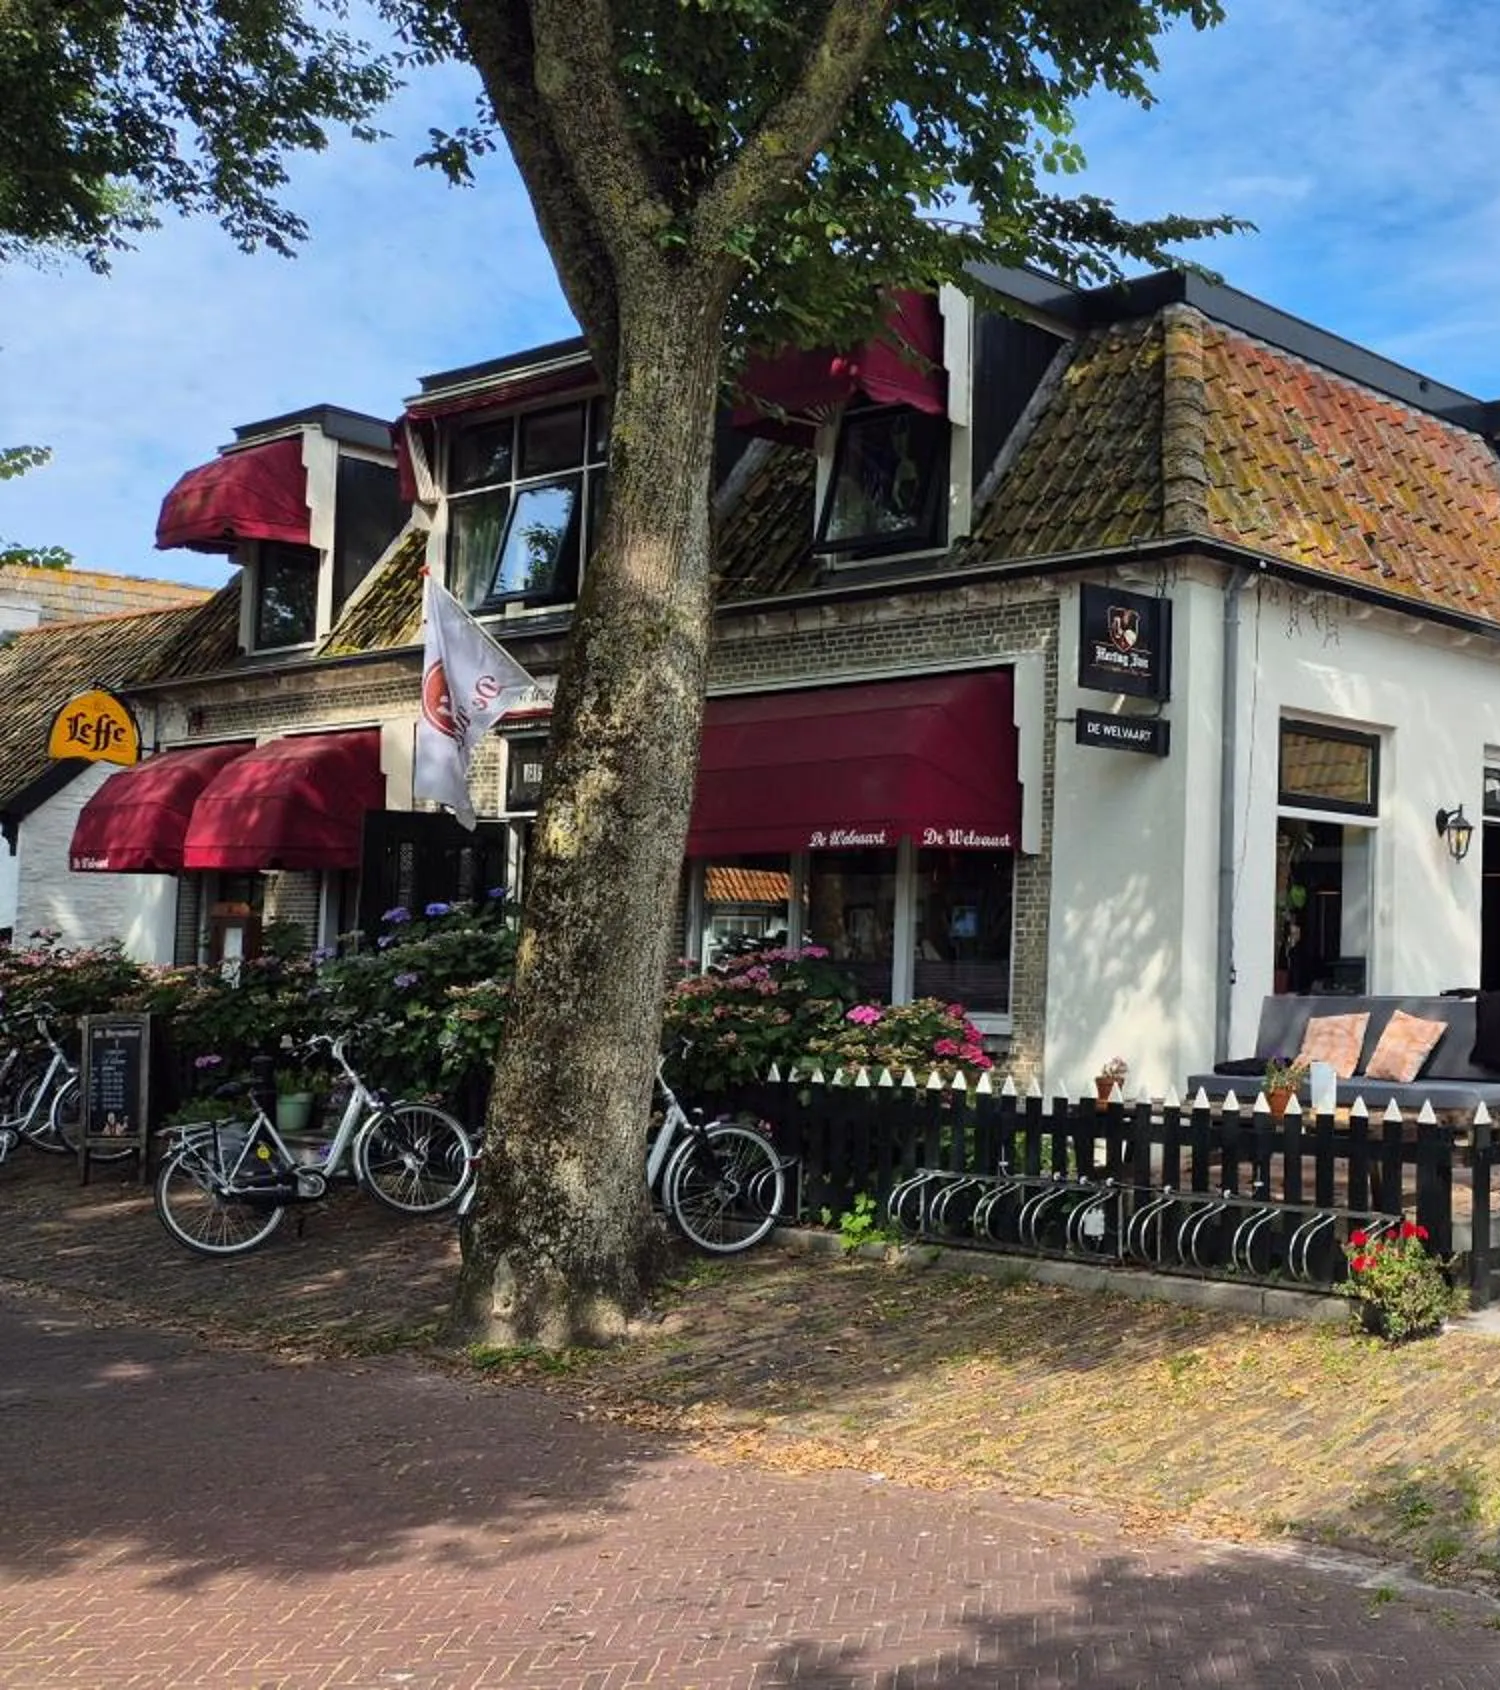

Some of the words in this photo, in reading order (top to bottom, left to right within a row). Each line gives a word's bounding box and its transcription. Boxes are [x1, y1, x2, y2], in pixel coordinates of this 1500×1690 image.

[65, 711, 127, 753] Leffe
[1087, 722, 1101, 735] DE
[1102, 724, 1152, 742] WELVAART
[809, 831, 827, 847] De
[829, 829, 886, 846] Welvaart
[923, 827, 945, 846] De
[948, 829, 1011, 847] Welvaart
